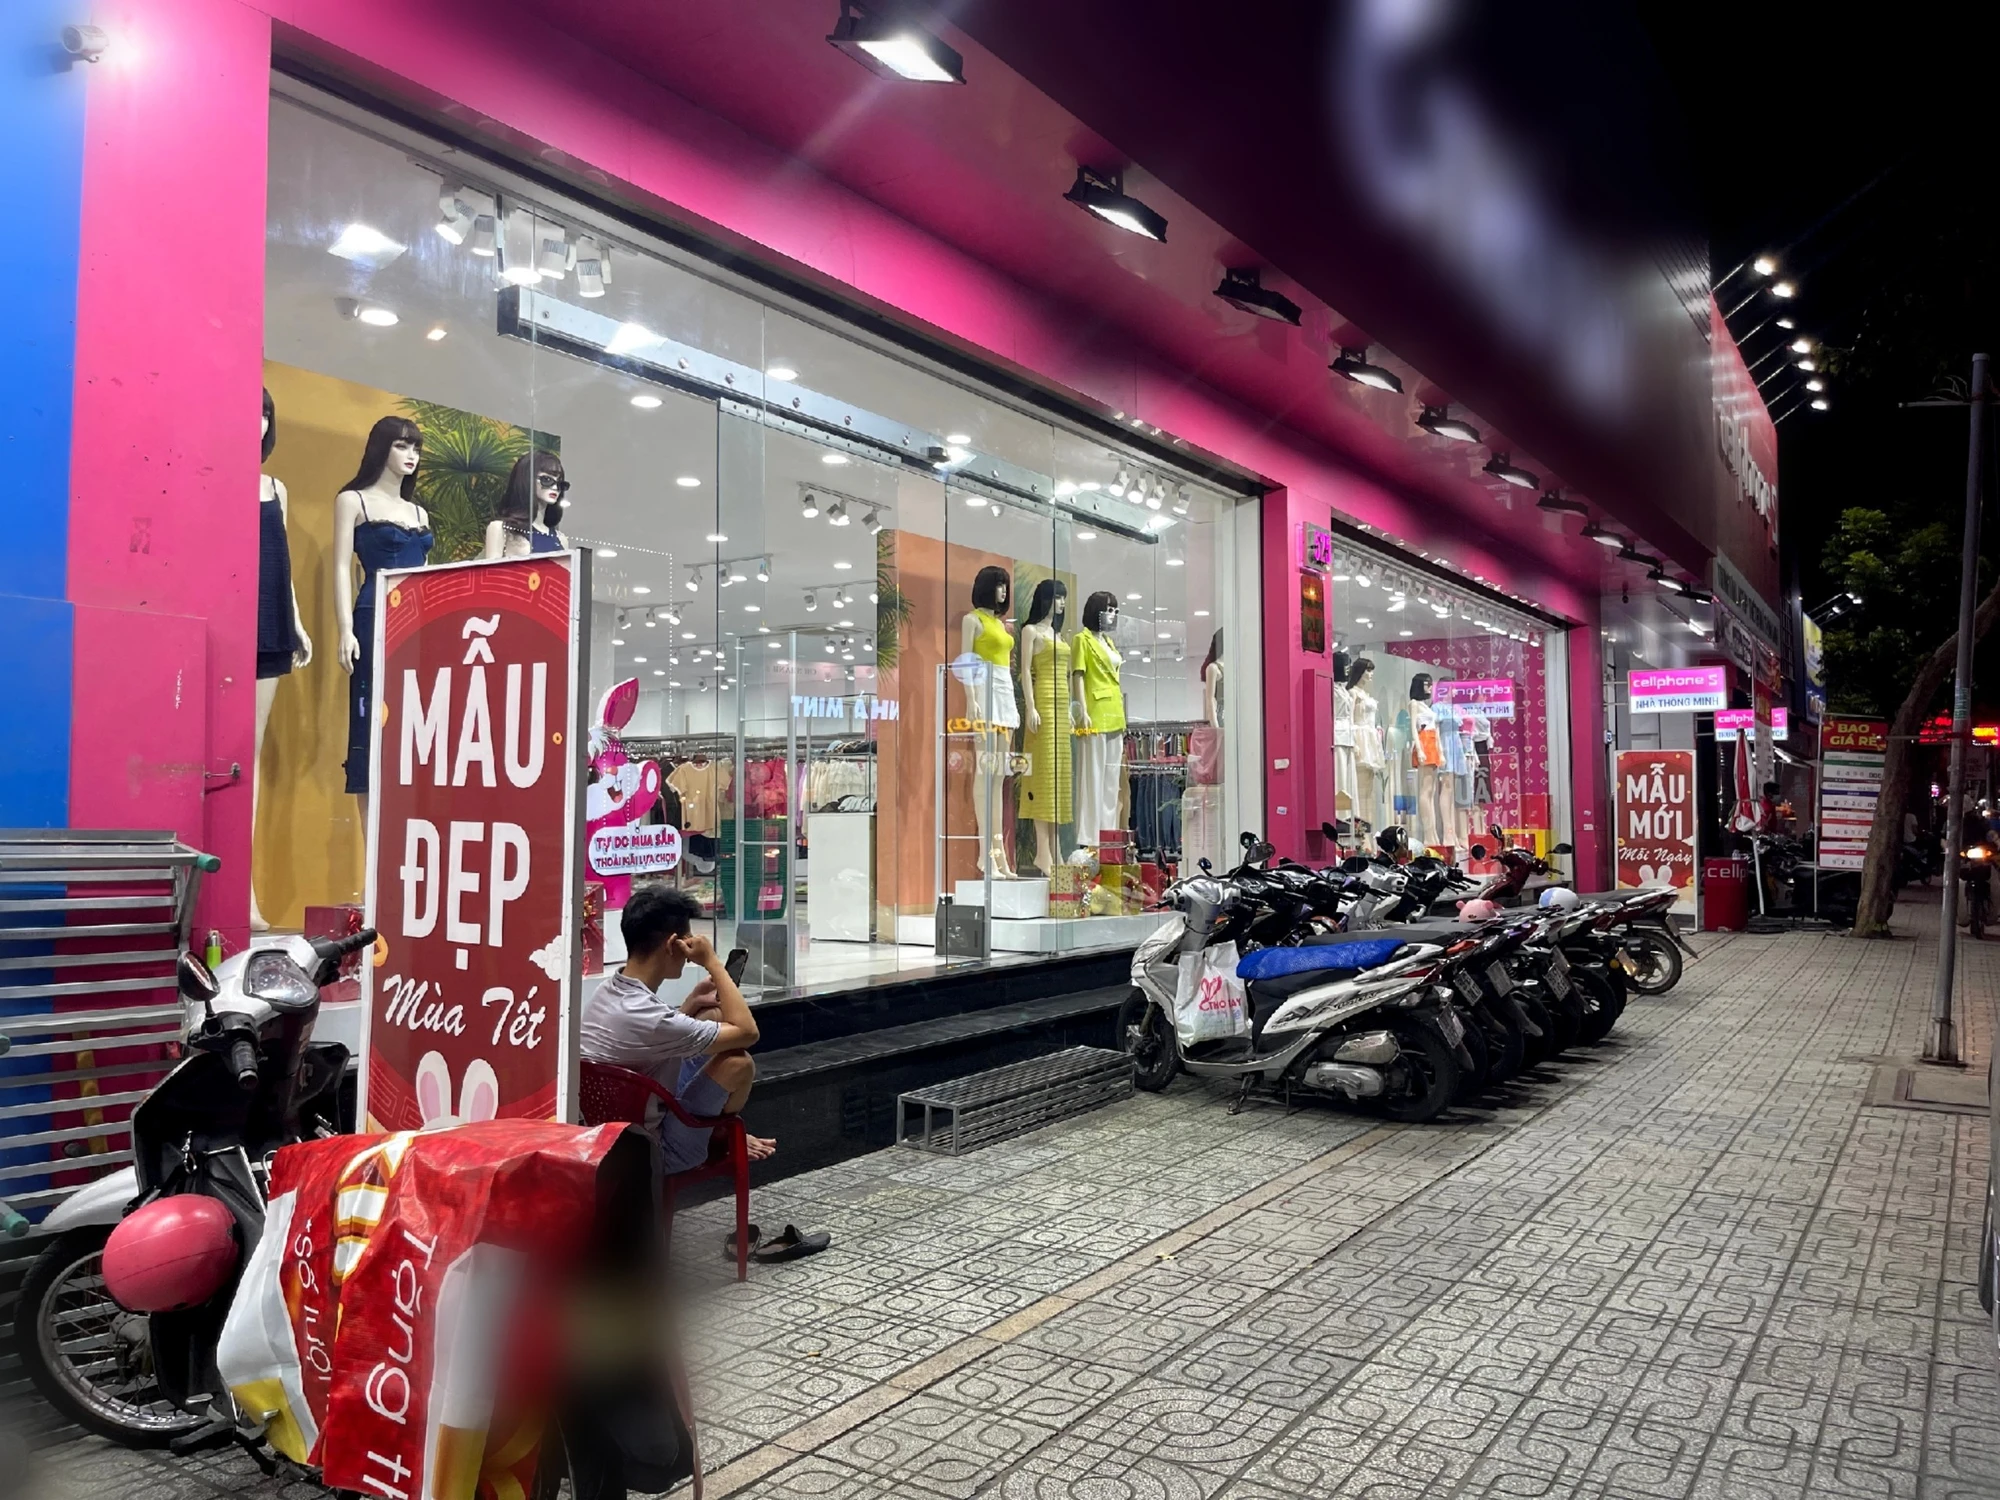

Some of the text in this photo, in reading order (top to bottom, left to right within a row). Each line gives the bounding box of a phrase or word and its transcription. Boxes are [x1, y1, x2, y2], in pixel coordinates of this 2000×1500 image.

[400, 614, 547, 788] MẪU
[1693, 696, 1718, 707] MINH
[1830, 733, 1855, 745] GIÁ
[1838, 723, 1870, 733] BAO
[1626, 763, 1685, 804] MẪU
[1629, 803, 1683, 840] MỚI
[614, 835, 630, 848] DO
[631, 834, 653, 847] MUA
[1619, 847, 1693, 865] Mỗi Ngày
[400, 818, 531, 971] ĐẸP
[383, 974, 546, 1049] Mùa Tết
[365, 1229, 438, 1425] Tặng
